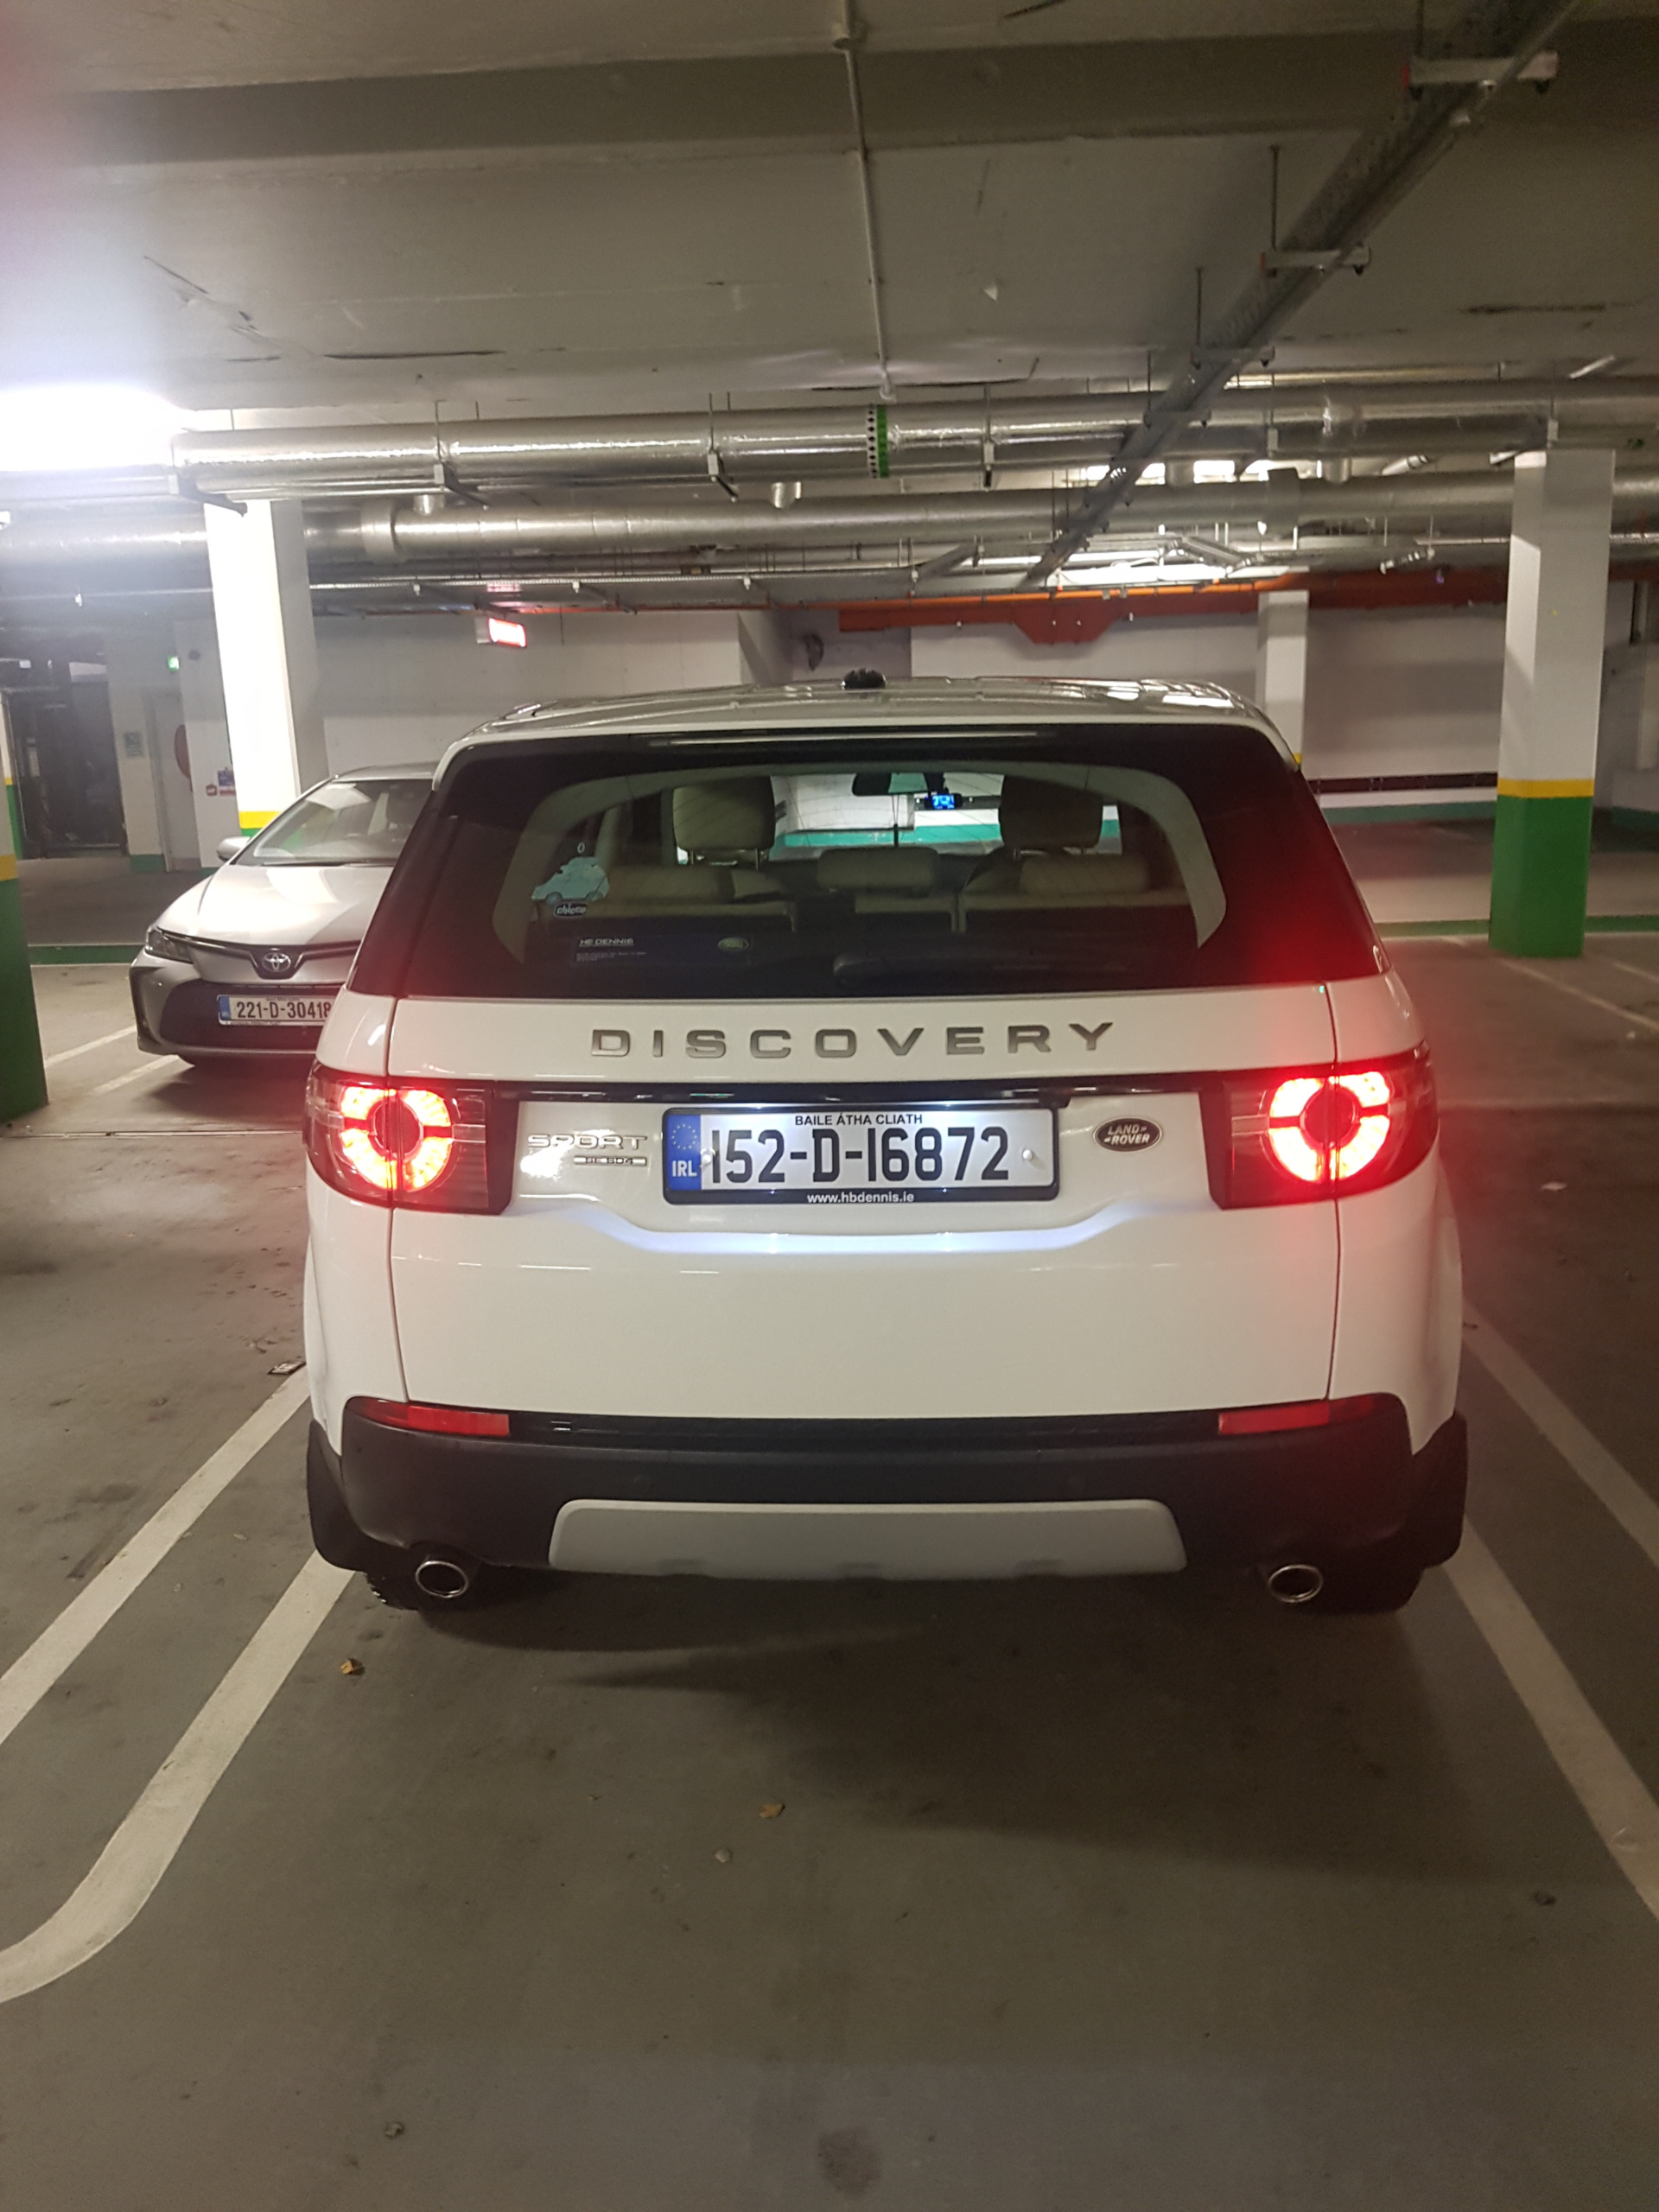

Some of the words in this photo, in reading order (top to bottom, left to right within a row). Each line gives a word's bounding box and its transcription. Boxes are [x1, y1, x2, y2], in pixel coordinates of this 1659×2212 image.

[591, 1021, 1114, 1058] DISCOVERY
[794, 1115, 835, 1126] BAILE
[836, 1112, 872, 1125] ÁTHA
[875, 1114, 924, 1125] CLIATH
[527, 1134, 647, 1150] SPORT
[710, 1126, 1010, 1185] 152-D-16872
[671, 1160, 698, 1178] IRL
[806, 1190, 915, 1204] www.hbdennis.ie
